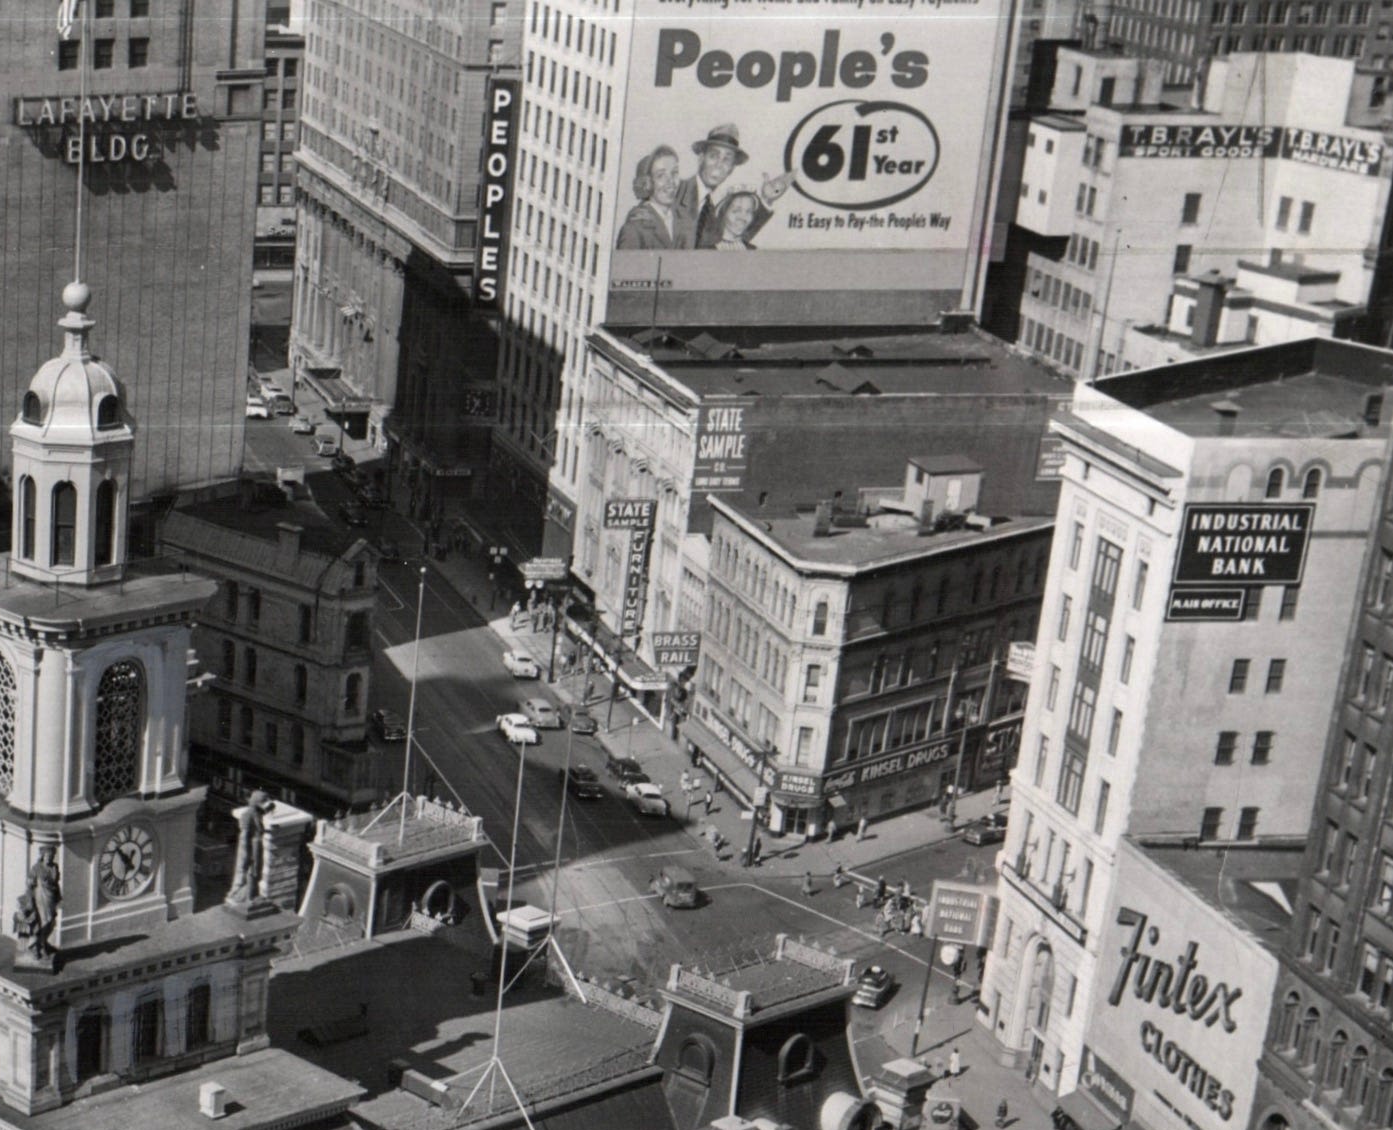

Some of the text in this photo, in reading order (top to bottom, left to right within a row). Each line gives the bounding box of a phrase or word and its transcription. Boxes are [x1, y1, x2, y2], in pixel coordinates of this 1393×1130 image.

[655, 28, 929, 102] People's
[18, 92, 198, 126] LAFAYETTE
[873, 155, 925, 174] Year
[479, 89, 512, 301] PEOPLES
[807, 213, 832, 231] Easy
[834, 215, 845, 228] to
[929, 213, 951, 231] Way
[707, 408, 744, 432] STATE
[699, 435, 746, 459] SAMPLE
[608, 502, 651, 517] STATE
[607, 518, 650, 528] SAMPLE
[1191, 513, 1303, 531] INDUSTRIAL
[1197, 536, 1290, 553] NATIONAL
[1211, 557, 1265, 575] BANK
[623, 530, 645, 631] FURNITURE
[654, 633, 699, 648] BRASS
[660, 650, 692, 664] RAIL
[861, 743, 949, 782] KINSEL DRUGS
[1140, 1019, 1235, 1121] CLOTHES
